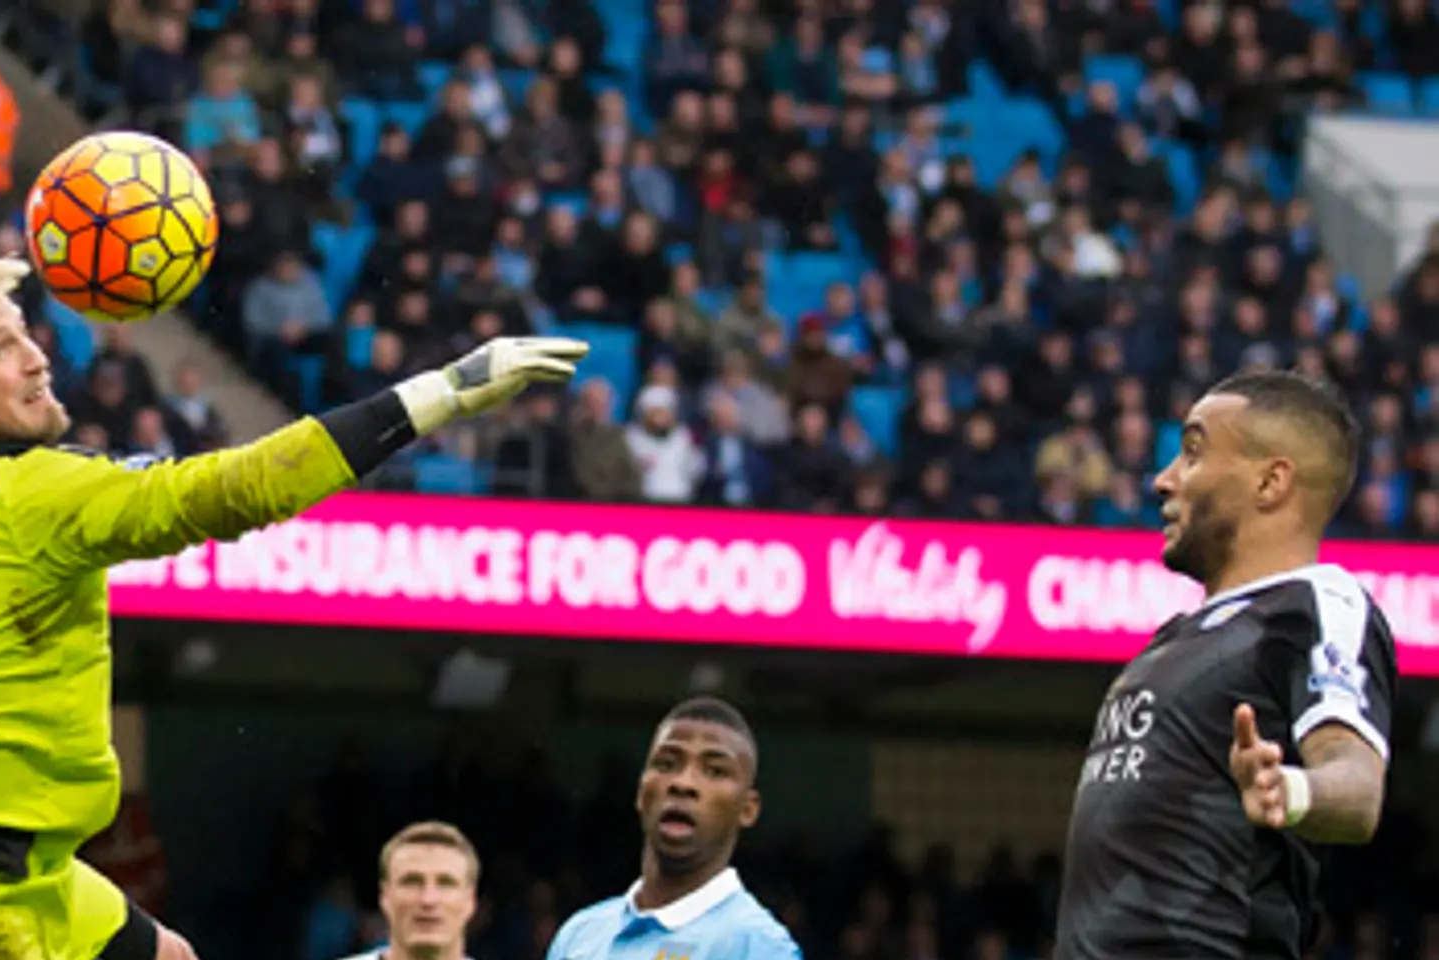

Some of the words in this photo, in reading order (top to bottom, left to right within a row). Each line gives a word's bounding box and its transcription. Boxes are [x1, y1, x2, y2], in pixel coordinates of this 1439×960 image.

[215, 518, 523, 604] INSURANCE
[527, 531, 640, 608] FOR
[641, 537, 806, 616] GOOD
[829, 524, 1006, 652] Vitality
